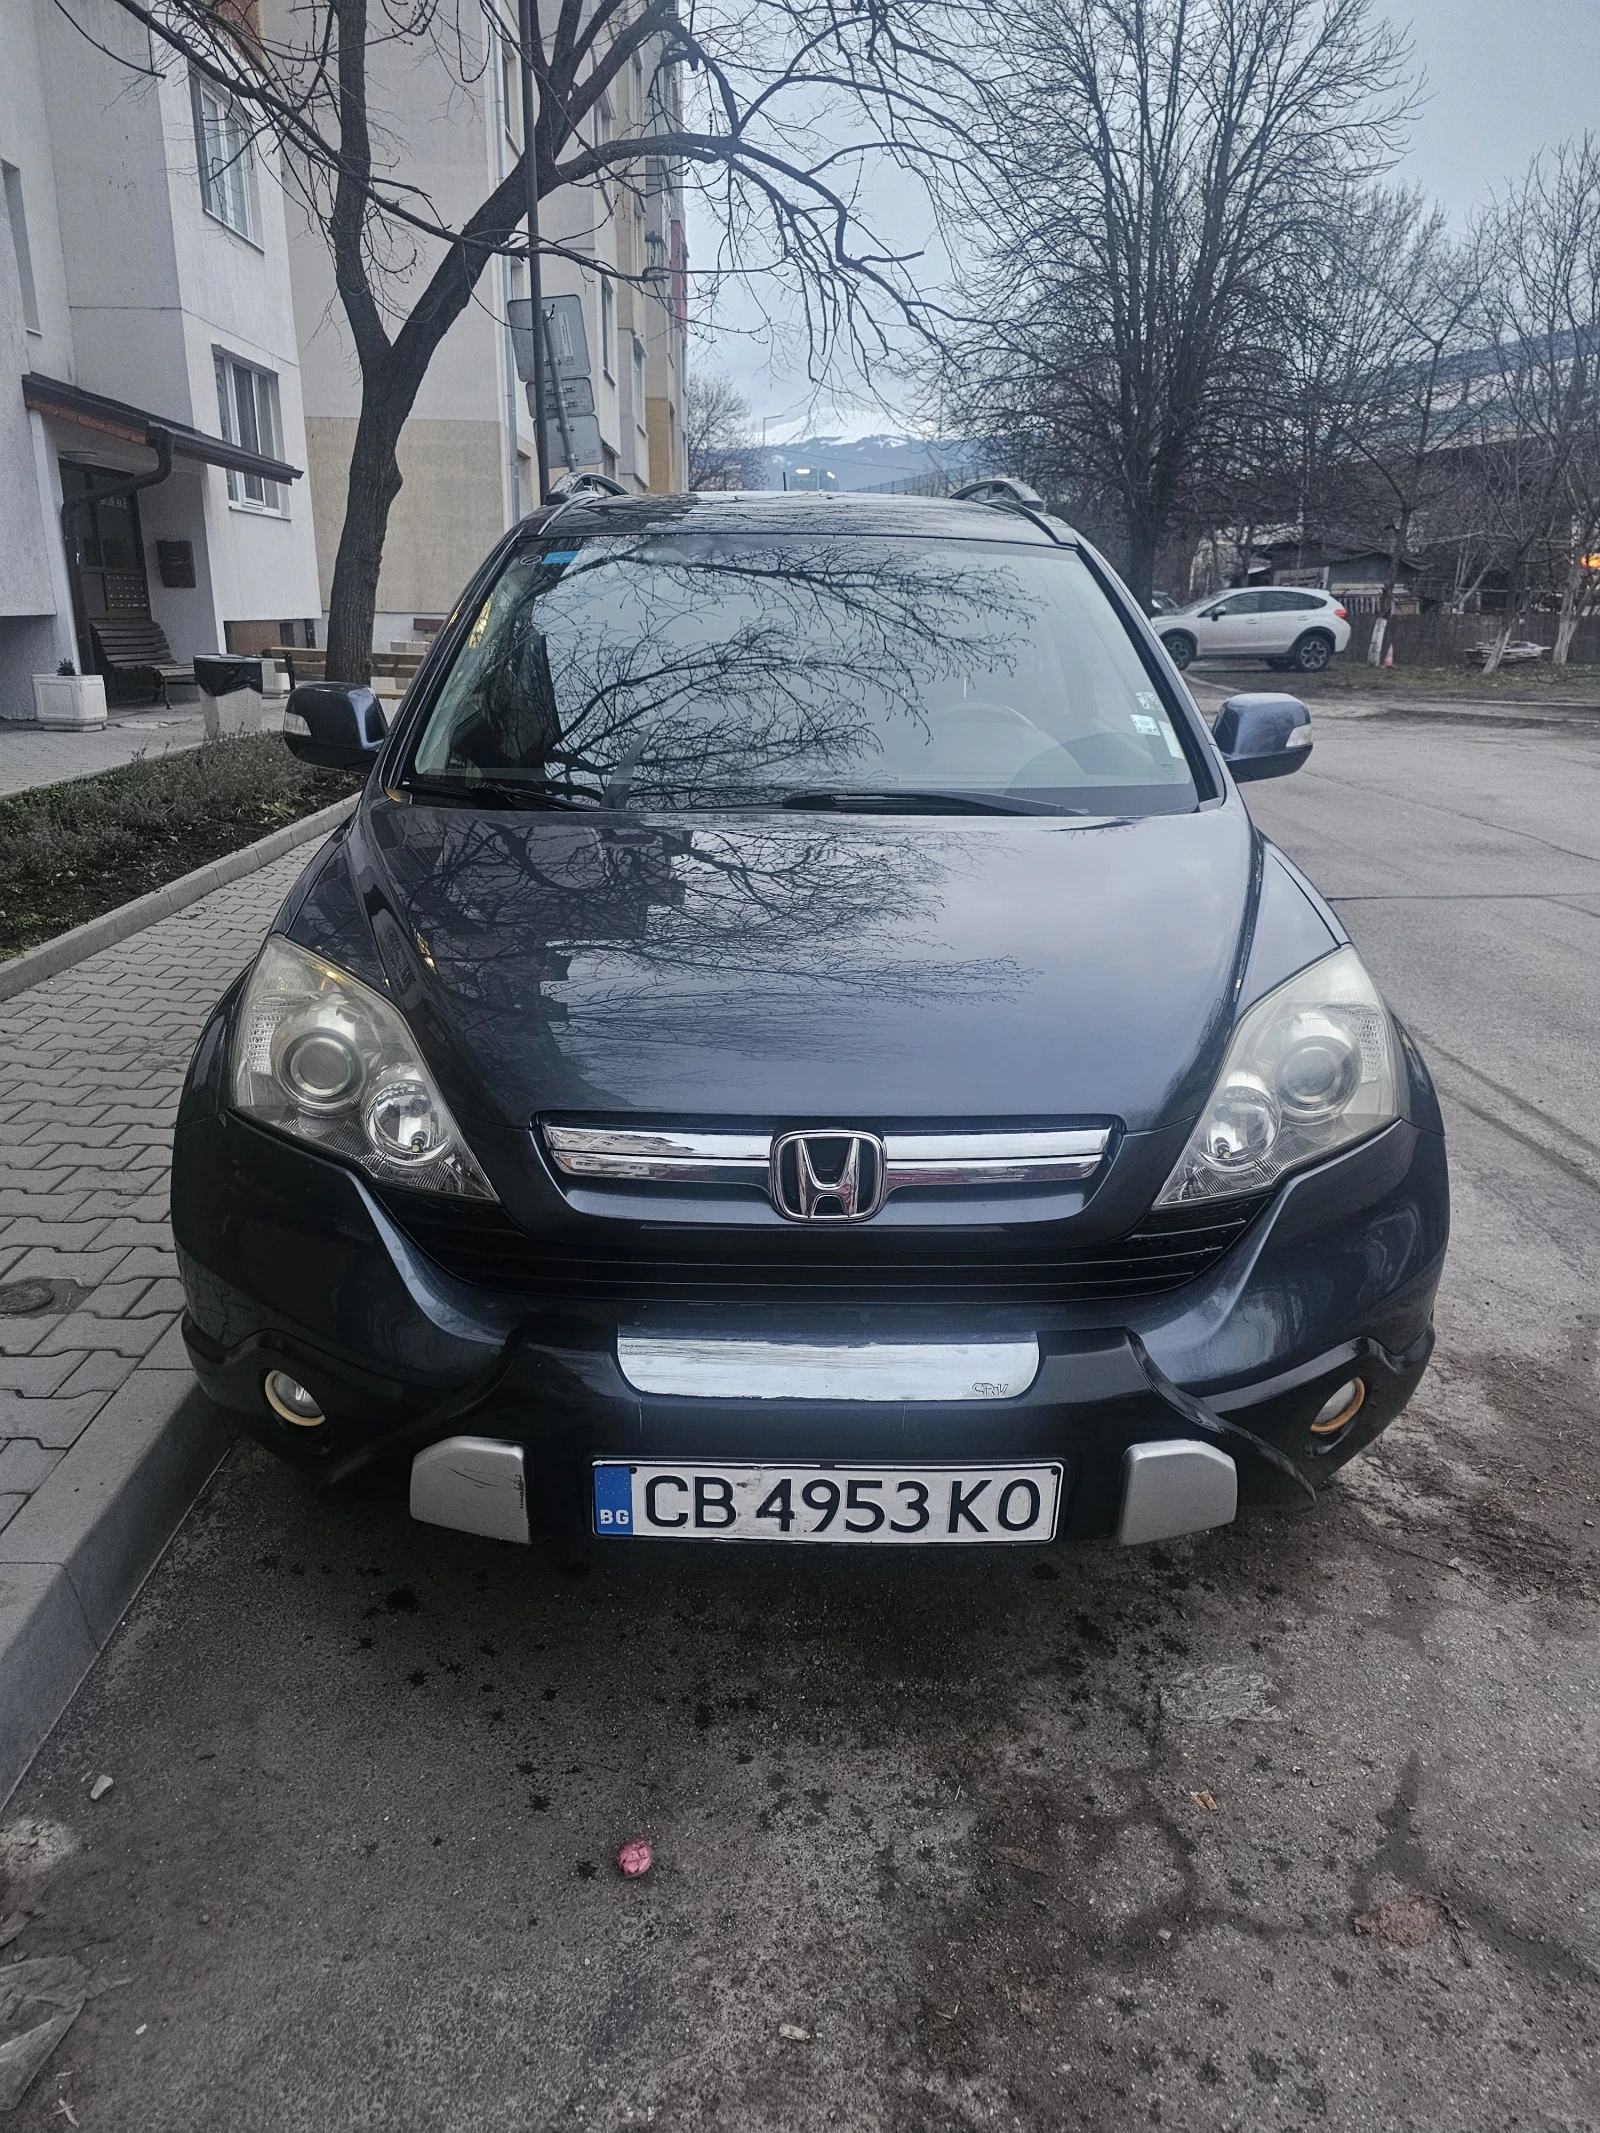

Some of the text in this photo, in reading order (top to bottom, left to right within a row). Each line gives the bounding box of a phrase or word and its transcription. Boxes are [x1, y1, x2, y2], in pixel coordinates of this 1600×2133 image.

[600, 1509, 630, 1525] BG
[645, 1475, 1041, 1533] CB 4953 KO
